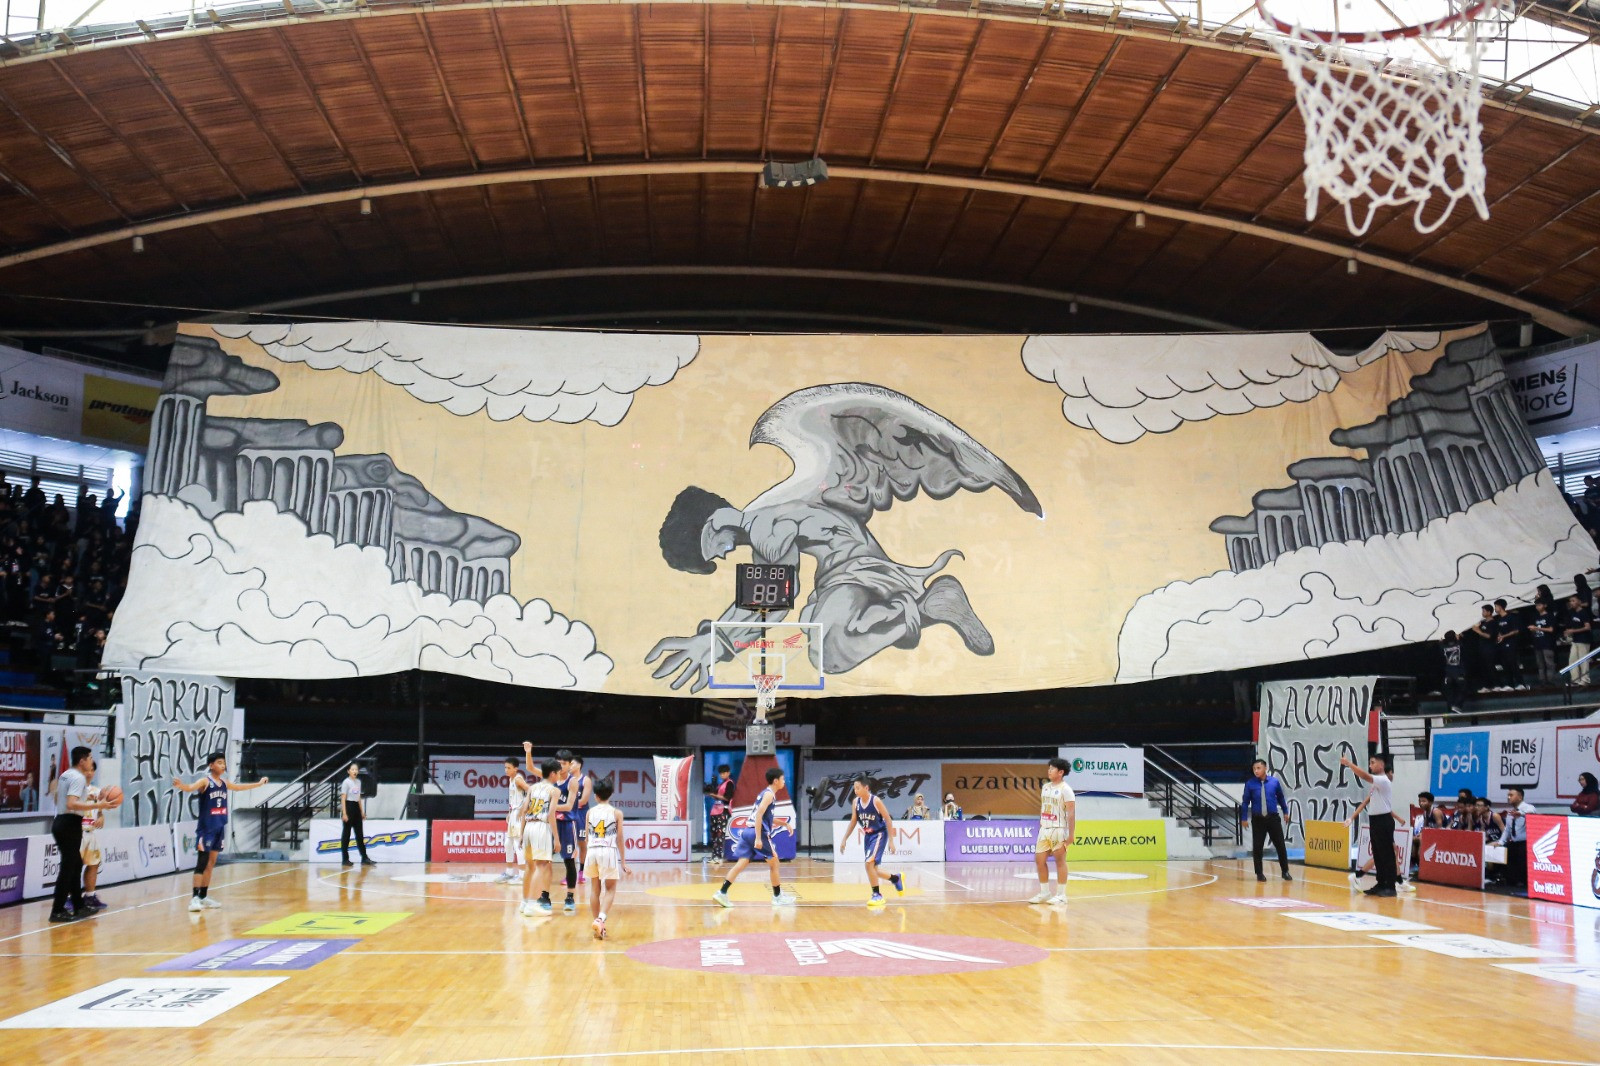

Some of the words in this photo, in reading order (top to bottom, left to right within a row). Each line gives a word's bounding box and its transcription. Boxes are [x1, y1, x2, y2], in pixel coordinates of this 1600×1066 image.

[10, 380, 70, 407] Jackson
[123, 675, 231, 724] TAKUT
[1266, 683, 1370, 730] LAWAN
[1085, 761, 1096, 770] RS
[1097, 761, 1129, 771] UBAYA
[1267, 740, 1365, 790] RASA
[1438, 740, 1480, 790] posh
[1500, 755, 1537, 777] Bioré
[594, 819, 605, 838] 4
[966, 827, 1003, 838] ULTRA
[1003, 827, 1032, 838] MILK
[443, 831, 472, 846] HOT
[649, 833, 682, 855] Day
[104, 847, 129, 864] Jackson
[566, 844, 573, 854] 8
[961, 845, 1010, 855] BLUEBERRY
[1013, 845, 1036, 854] BLAS
[1434, 850, 1478, 868] HONDA
[1533, 861, 1564, 874] HONDA
[1533, 880, 1545, 893] One
[784, 938, 829, 966] HONDA
